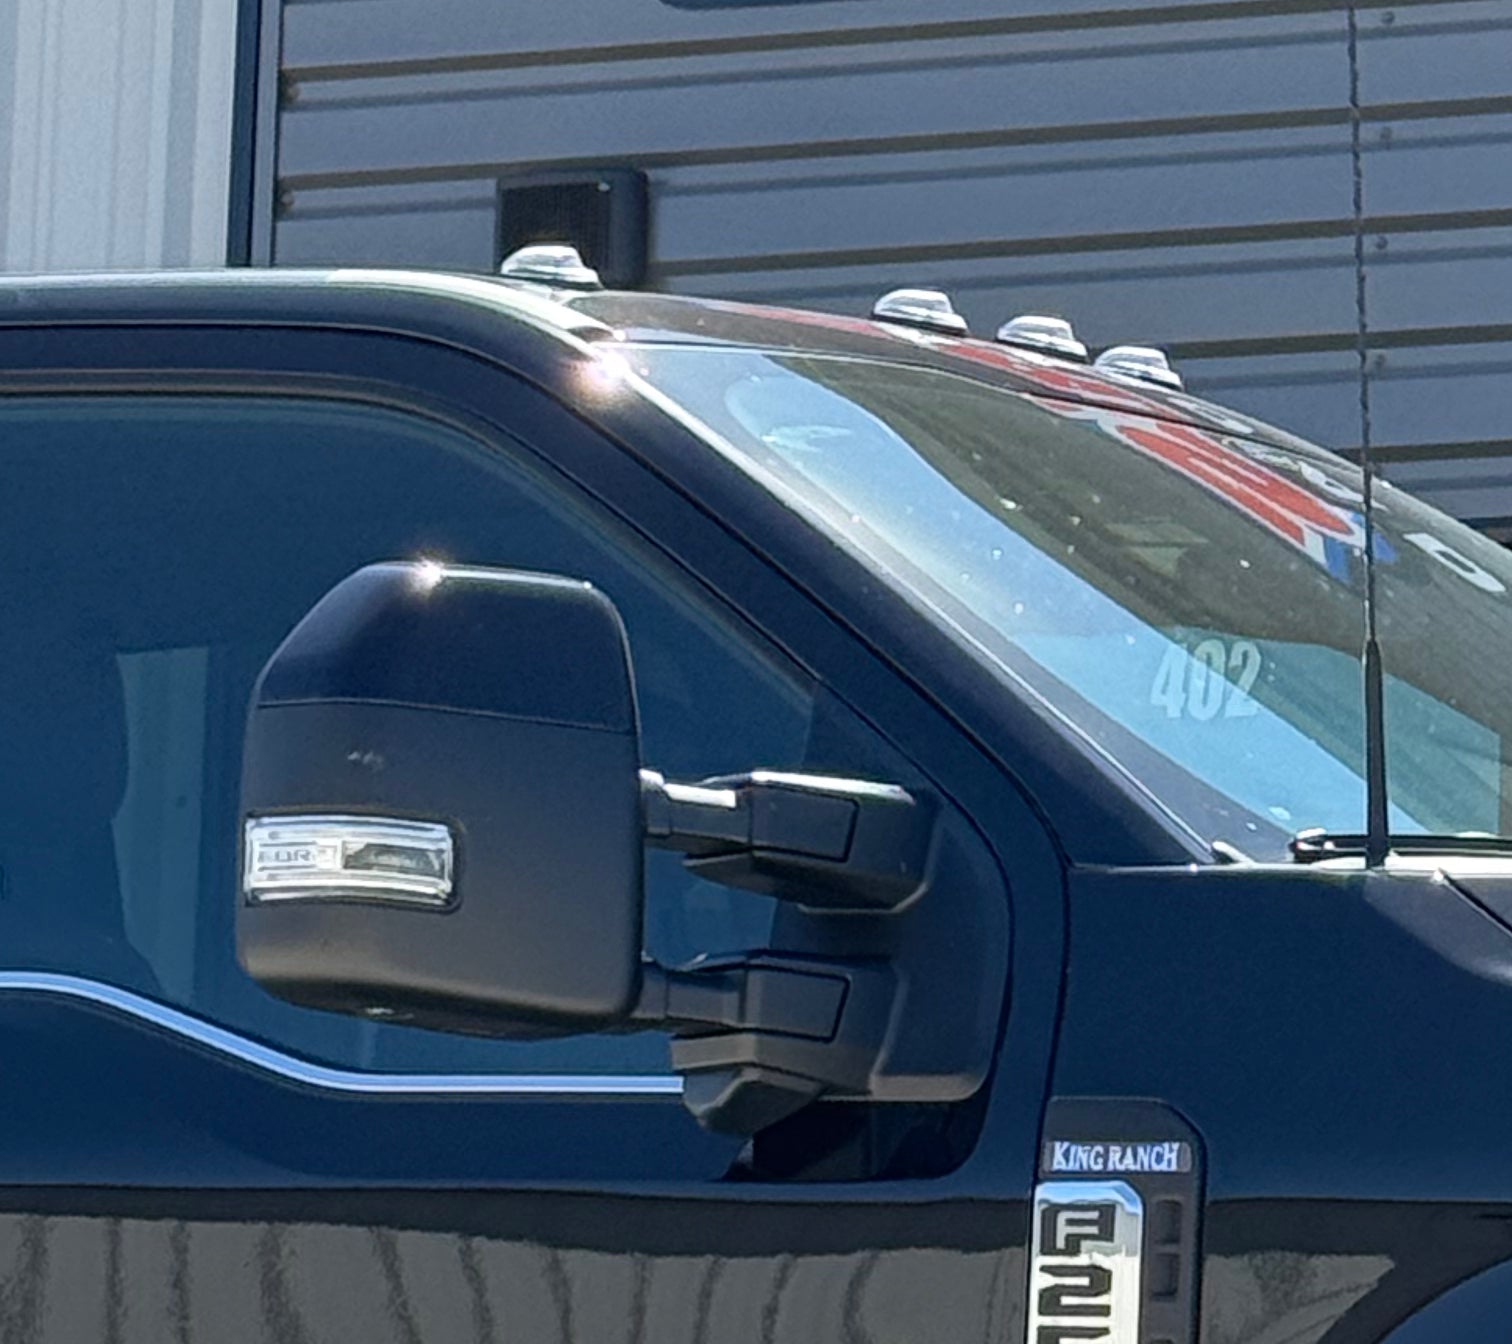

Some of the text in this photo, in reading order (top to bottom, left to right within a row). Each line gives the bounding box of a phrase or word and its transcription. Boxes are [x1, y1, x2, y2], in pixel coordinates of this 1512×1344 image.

[1150, 639, 1262, 721] 402
[1052, 1141, 1180, 1172] KING RANCH
